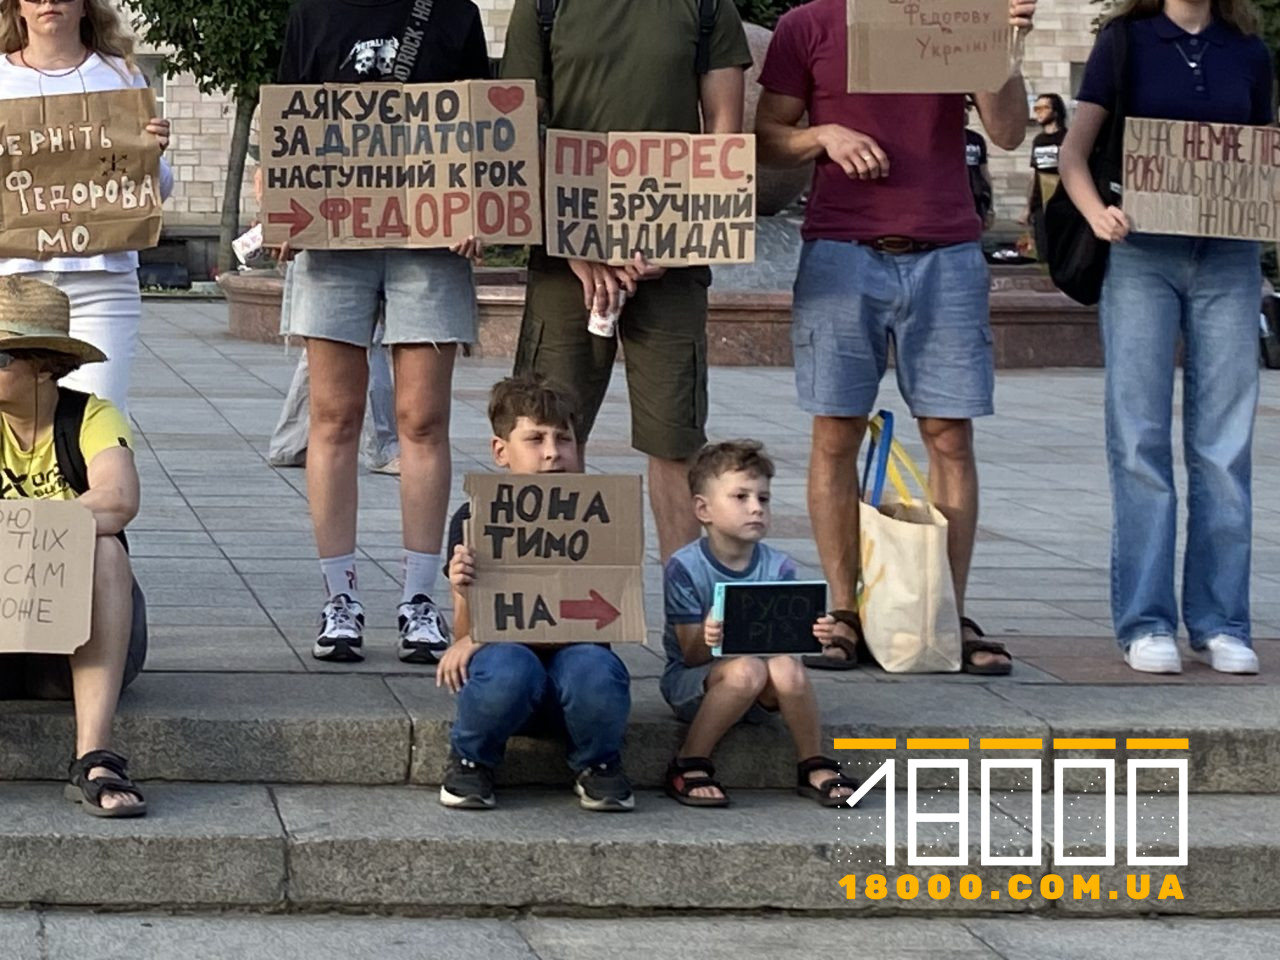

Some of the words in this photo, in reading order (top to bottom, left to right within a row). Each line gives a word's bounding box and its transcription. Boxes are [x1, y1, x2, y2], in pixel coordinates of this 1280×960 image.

[397, 26, 424, 67] ROCK
[281, 89, 460, 124] ДЯКУЄМО
[271, 125, 310, 158] ЗА
[315, 117, 516, 158] ДРАПАТОГО
[268, 159, 436, 189] НАСТУПНИЙ
[555, 137, 754, 184] ПРОГРЕС,
[5, 170, 158, 215] ФЕДОРОВА
[556, 186, 599, 220] НЕ
[608, 188, 753, 222] ЗРУЧНИЙ
[319, 190, 533, 238] ФЕДОРОВ
[37, 225, 90, 253] МО
[557, 220, 755, 260] КАНДИДАТ
[8, 528, 69, 551] ТИХ
[483, 525, 589, 562] ТИМО
[3, 562, 65, 589] САМ
[494, 592, 557, 631] НА
